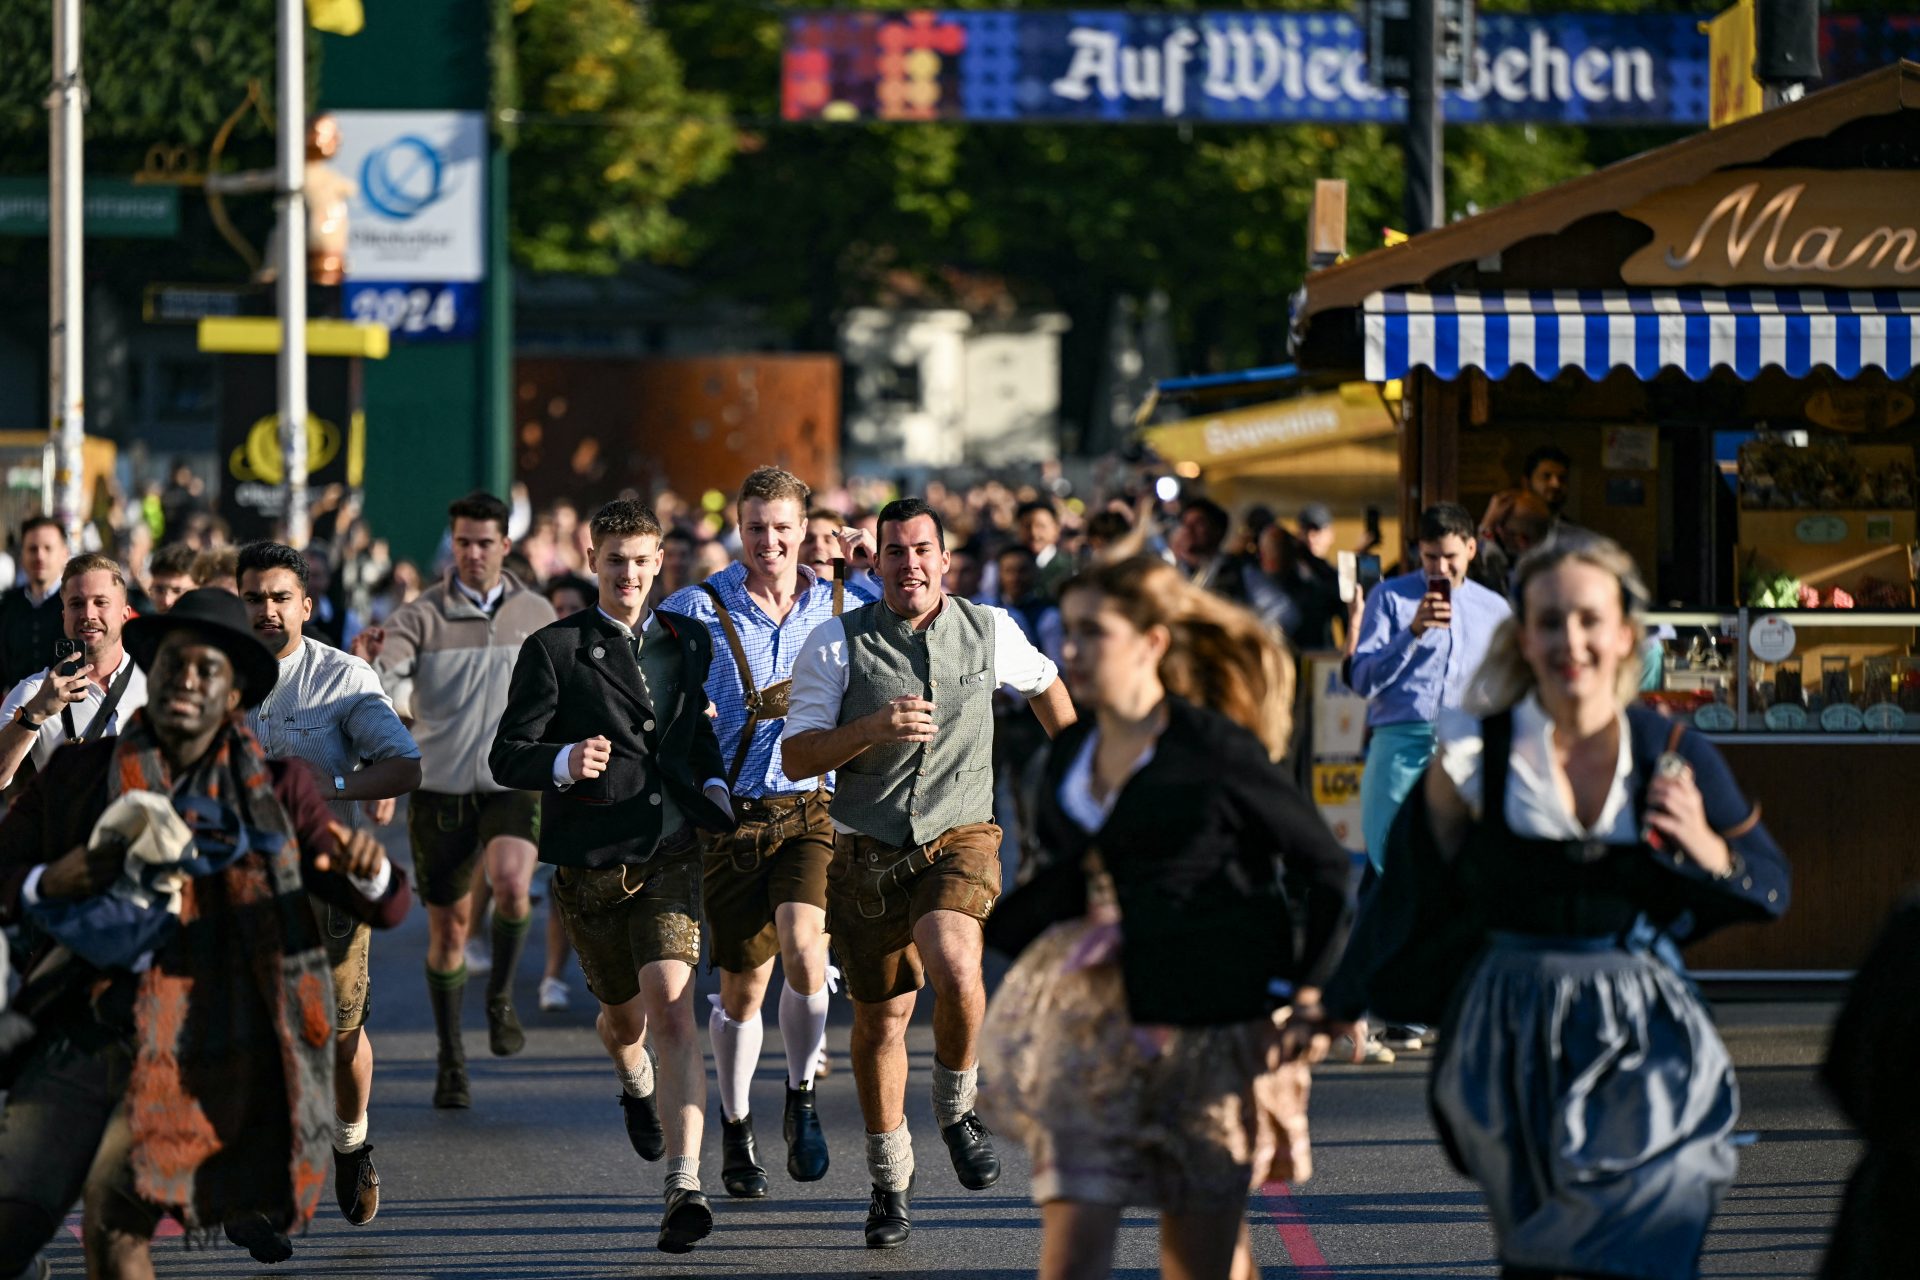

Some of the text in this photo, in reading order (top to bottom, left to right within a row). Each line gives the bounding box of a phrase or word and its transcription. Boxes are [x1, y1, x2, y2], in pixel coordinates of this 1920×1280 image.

[1052, 27, 1198, 116] Auf
[1204, 27, 1655, 103] Wiesehen
[351, 287, 456, 332] 2024
